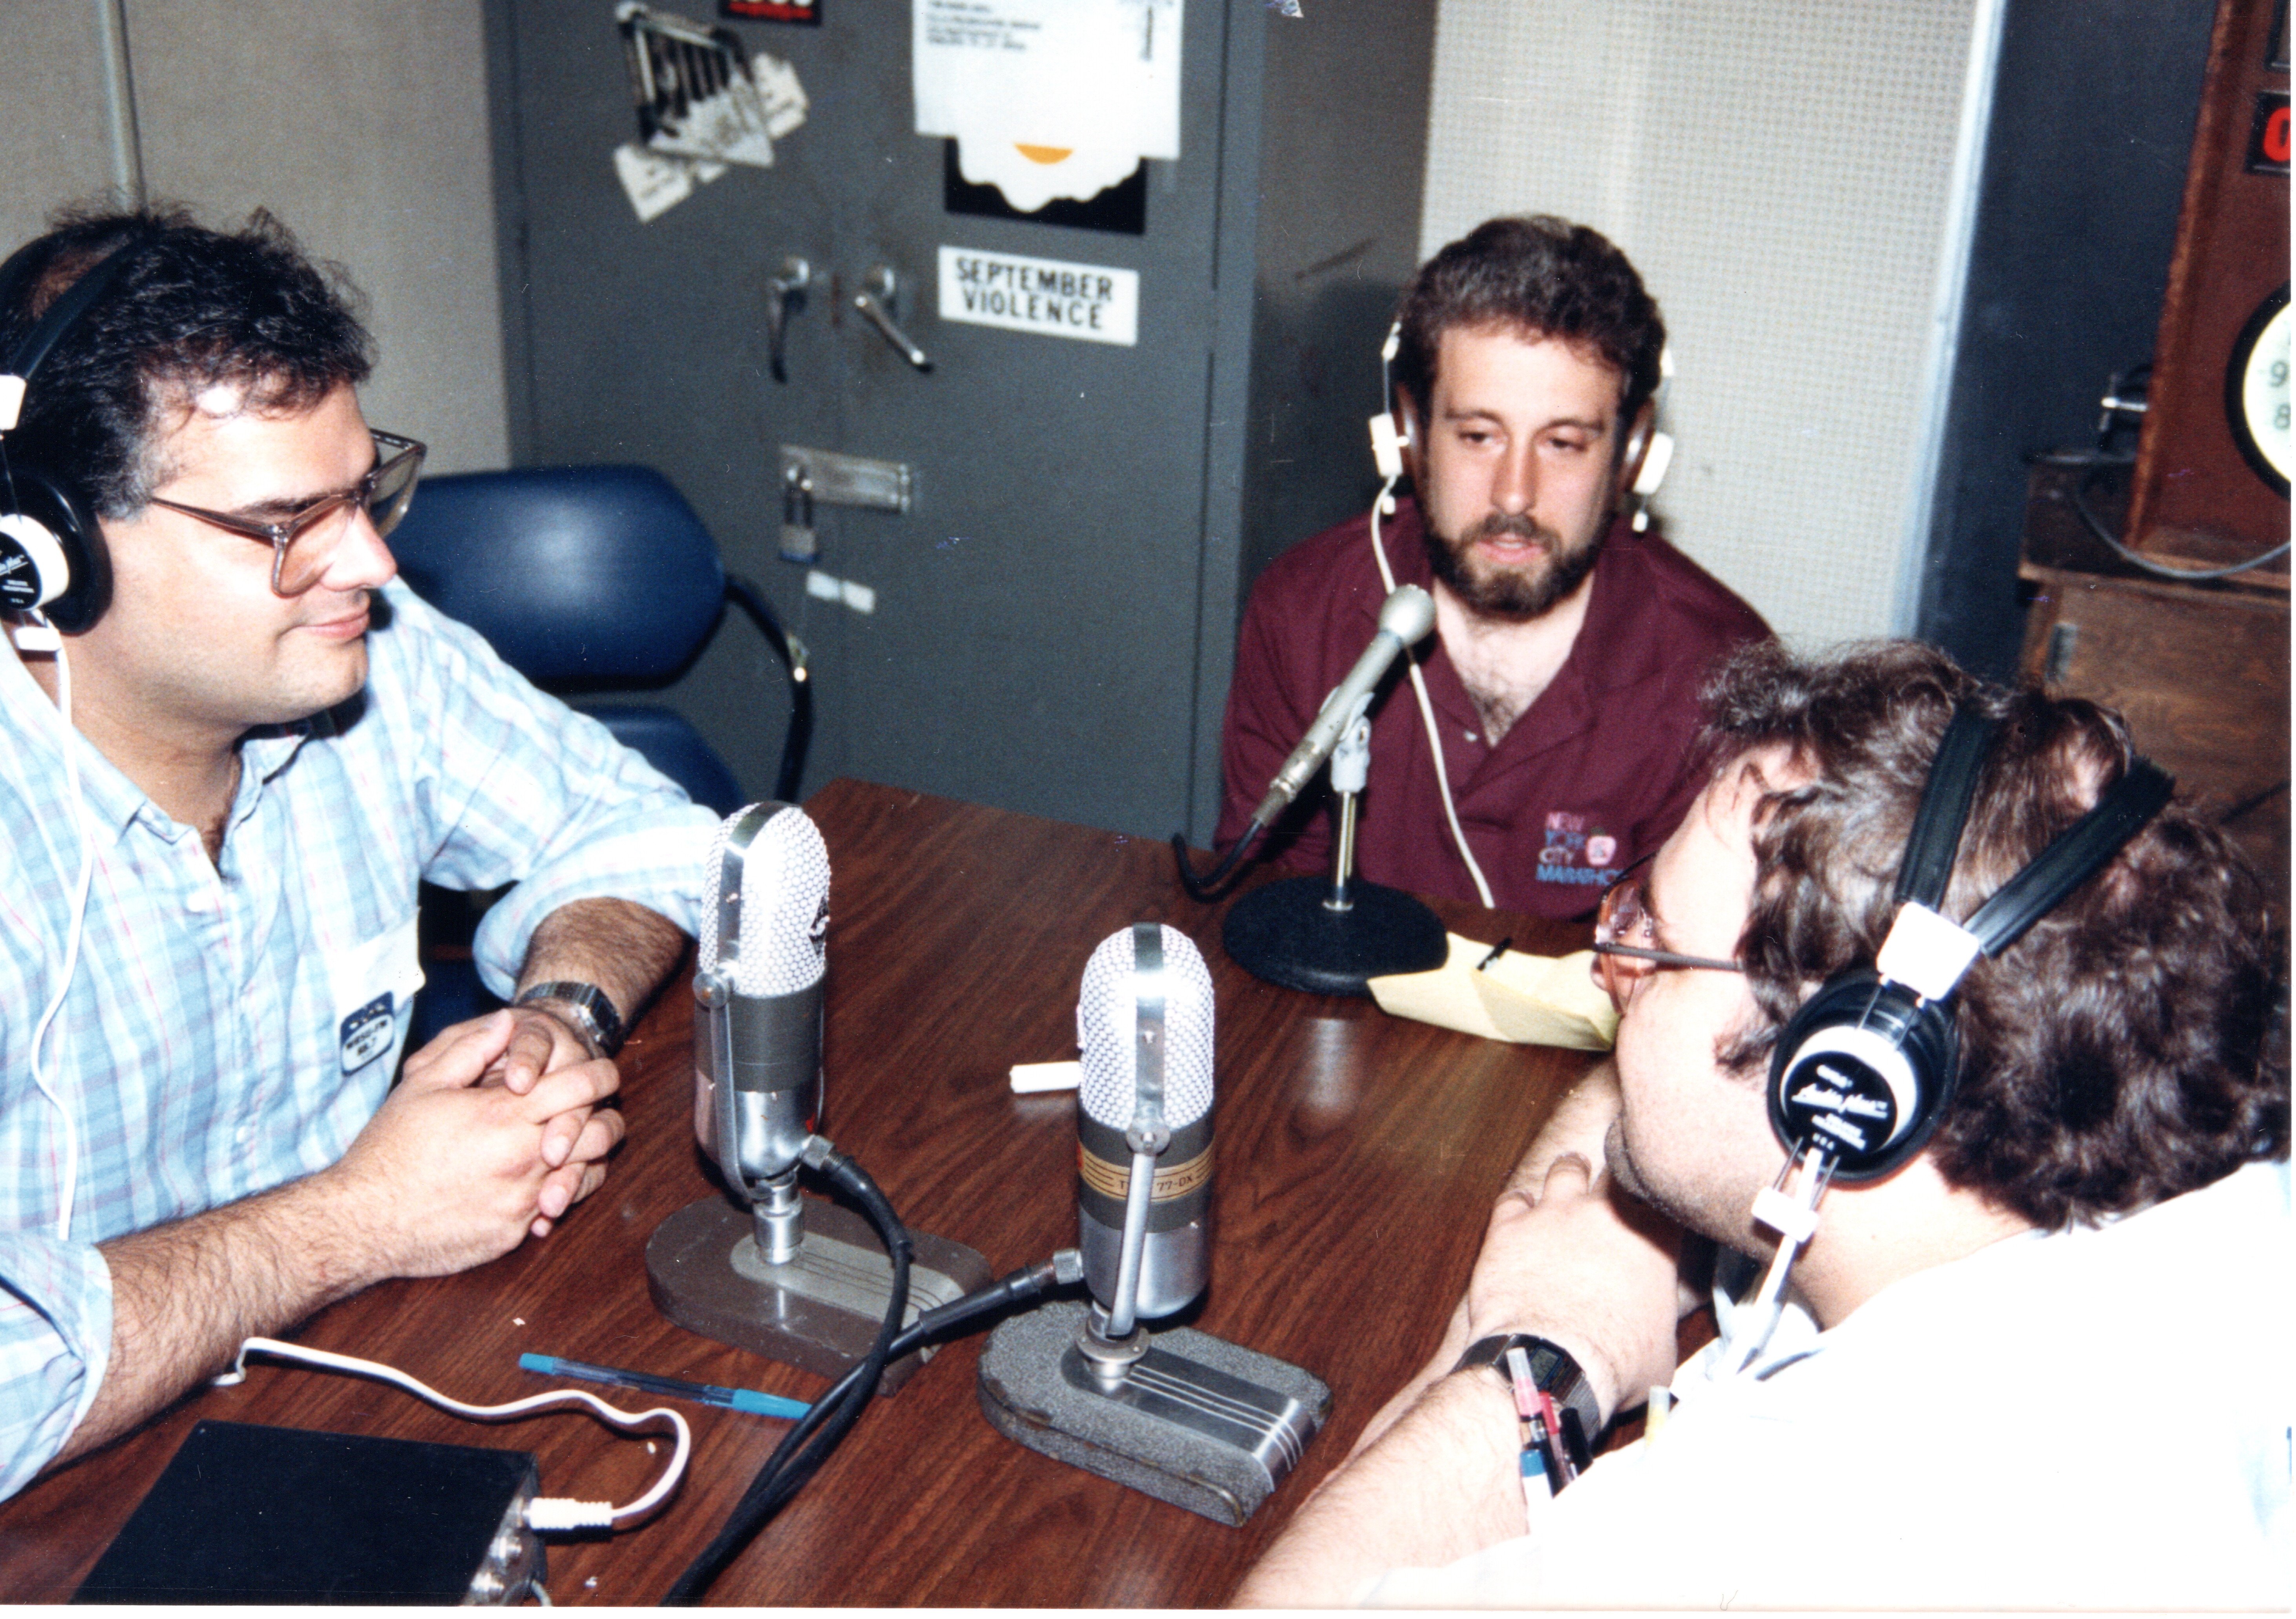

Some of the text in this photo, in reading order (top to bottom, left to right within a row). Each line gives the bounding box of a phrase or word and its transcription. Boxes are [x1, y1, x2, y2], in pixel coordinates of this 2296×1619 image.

[956, 257, 1112, 301] SEPTEMBER
[963, 288, 1102, 329] VIOLENCE
[2268, 360, 2289, 387] 9
[1547, 812, 1584, 831] NEW
[1539, 846, 1575, 864] CITY
